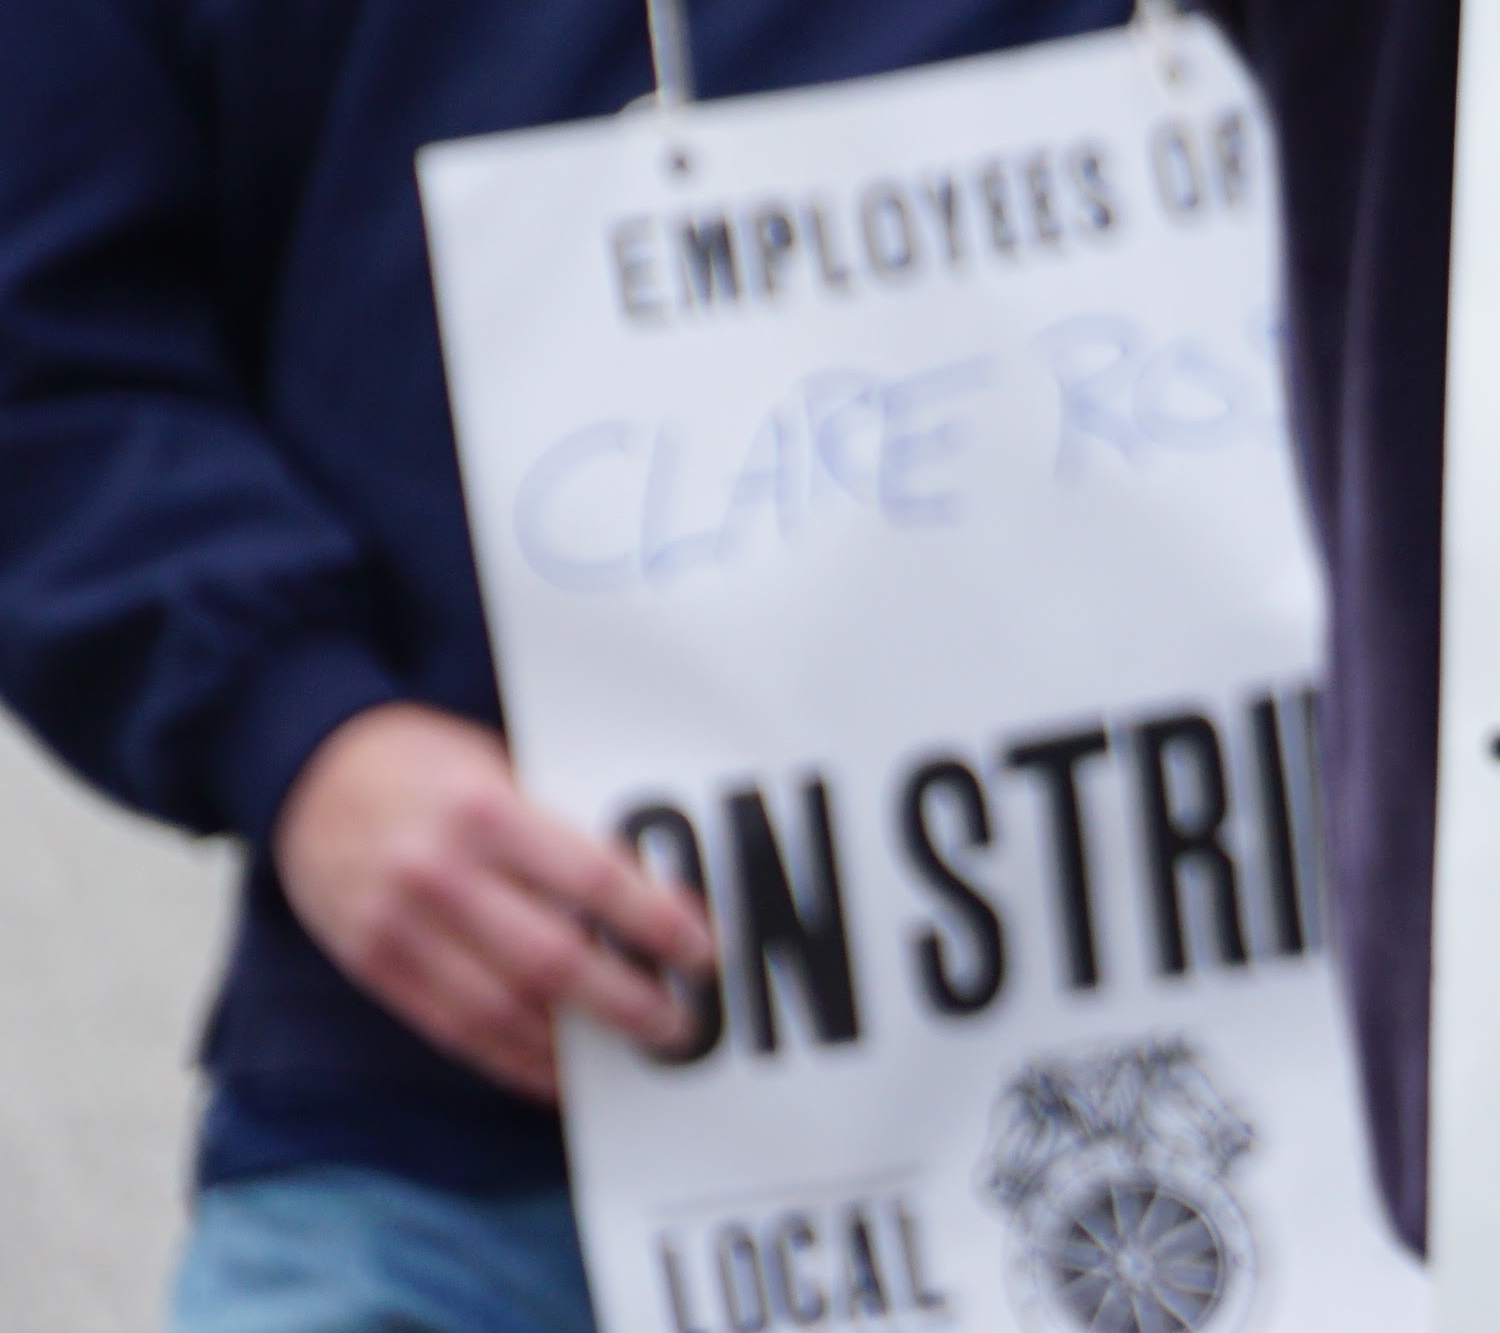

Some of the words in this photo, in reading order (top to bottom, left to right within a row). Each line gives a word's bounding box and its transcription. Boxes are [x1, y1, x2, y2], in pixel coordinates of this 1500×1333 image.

[611, 146, 1114, 322] EMPLOYEES
[513, 355, 995, 594] CLARE
[1031, 312, 1282, 485] RO
[621, 769, 861, 1065] ON
[896, 685, 1322, 1017] STRI
[657, 1199, 945, 1333] LOCAL
